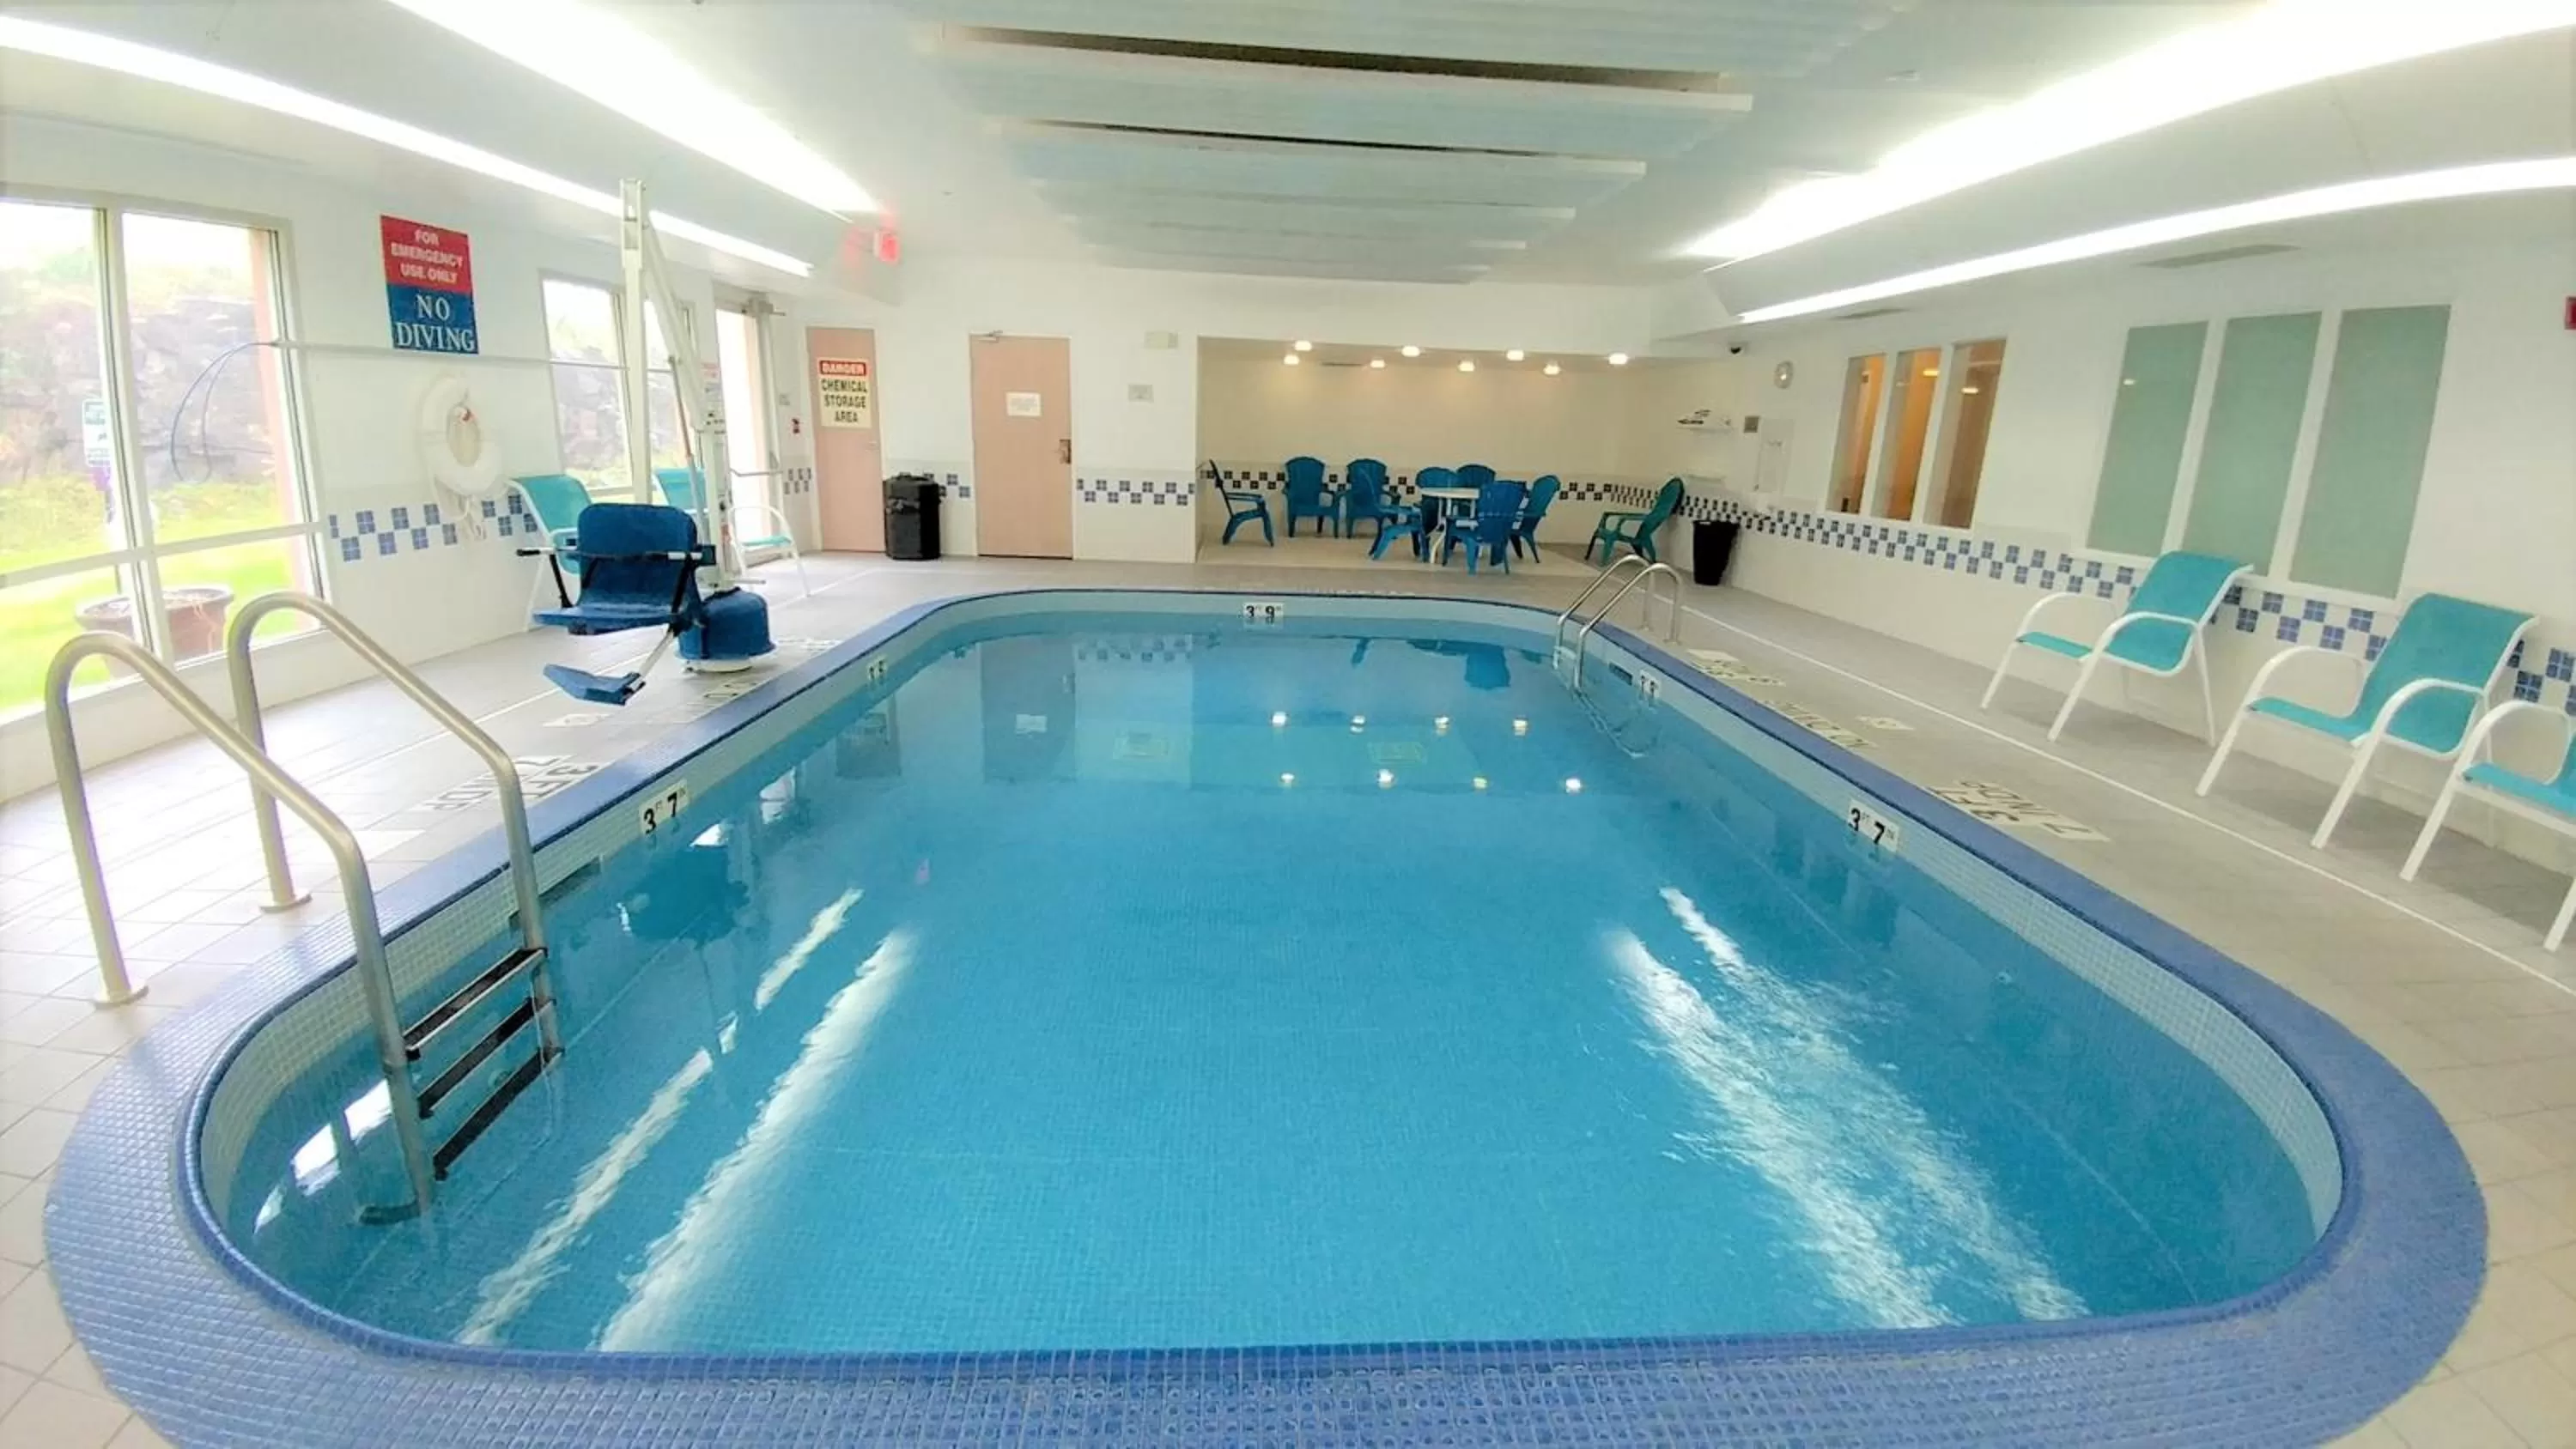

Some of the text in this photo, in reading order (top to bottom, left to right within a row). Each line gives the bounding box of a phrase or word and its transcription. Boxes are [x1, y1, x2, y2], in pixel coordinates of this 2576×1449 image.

[414, 228, 440, 246] FOR
[391, 242, 464, 267] EMERGENCY
[400, 263, 459, 284] USE ONLY
[416, 294, 451, 321] NO
[395, 322, 475, 351] DIVING
[821, 379, 867, 392] CHEMICAL
[824, 394, 866, 409] STORAGE
[835, 410, 858, 423] AREA
[1246, 605, 1255, 618] 3
[1265, 605, 1275, 618] 9
[644, 808, 657, 834] 3
[667, 791, 677, 818] 7
[1848, 808, 1860, 832] 3
[1874, 821, 1886, 846] 7
